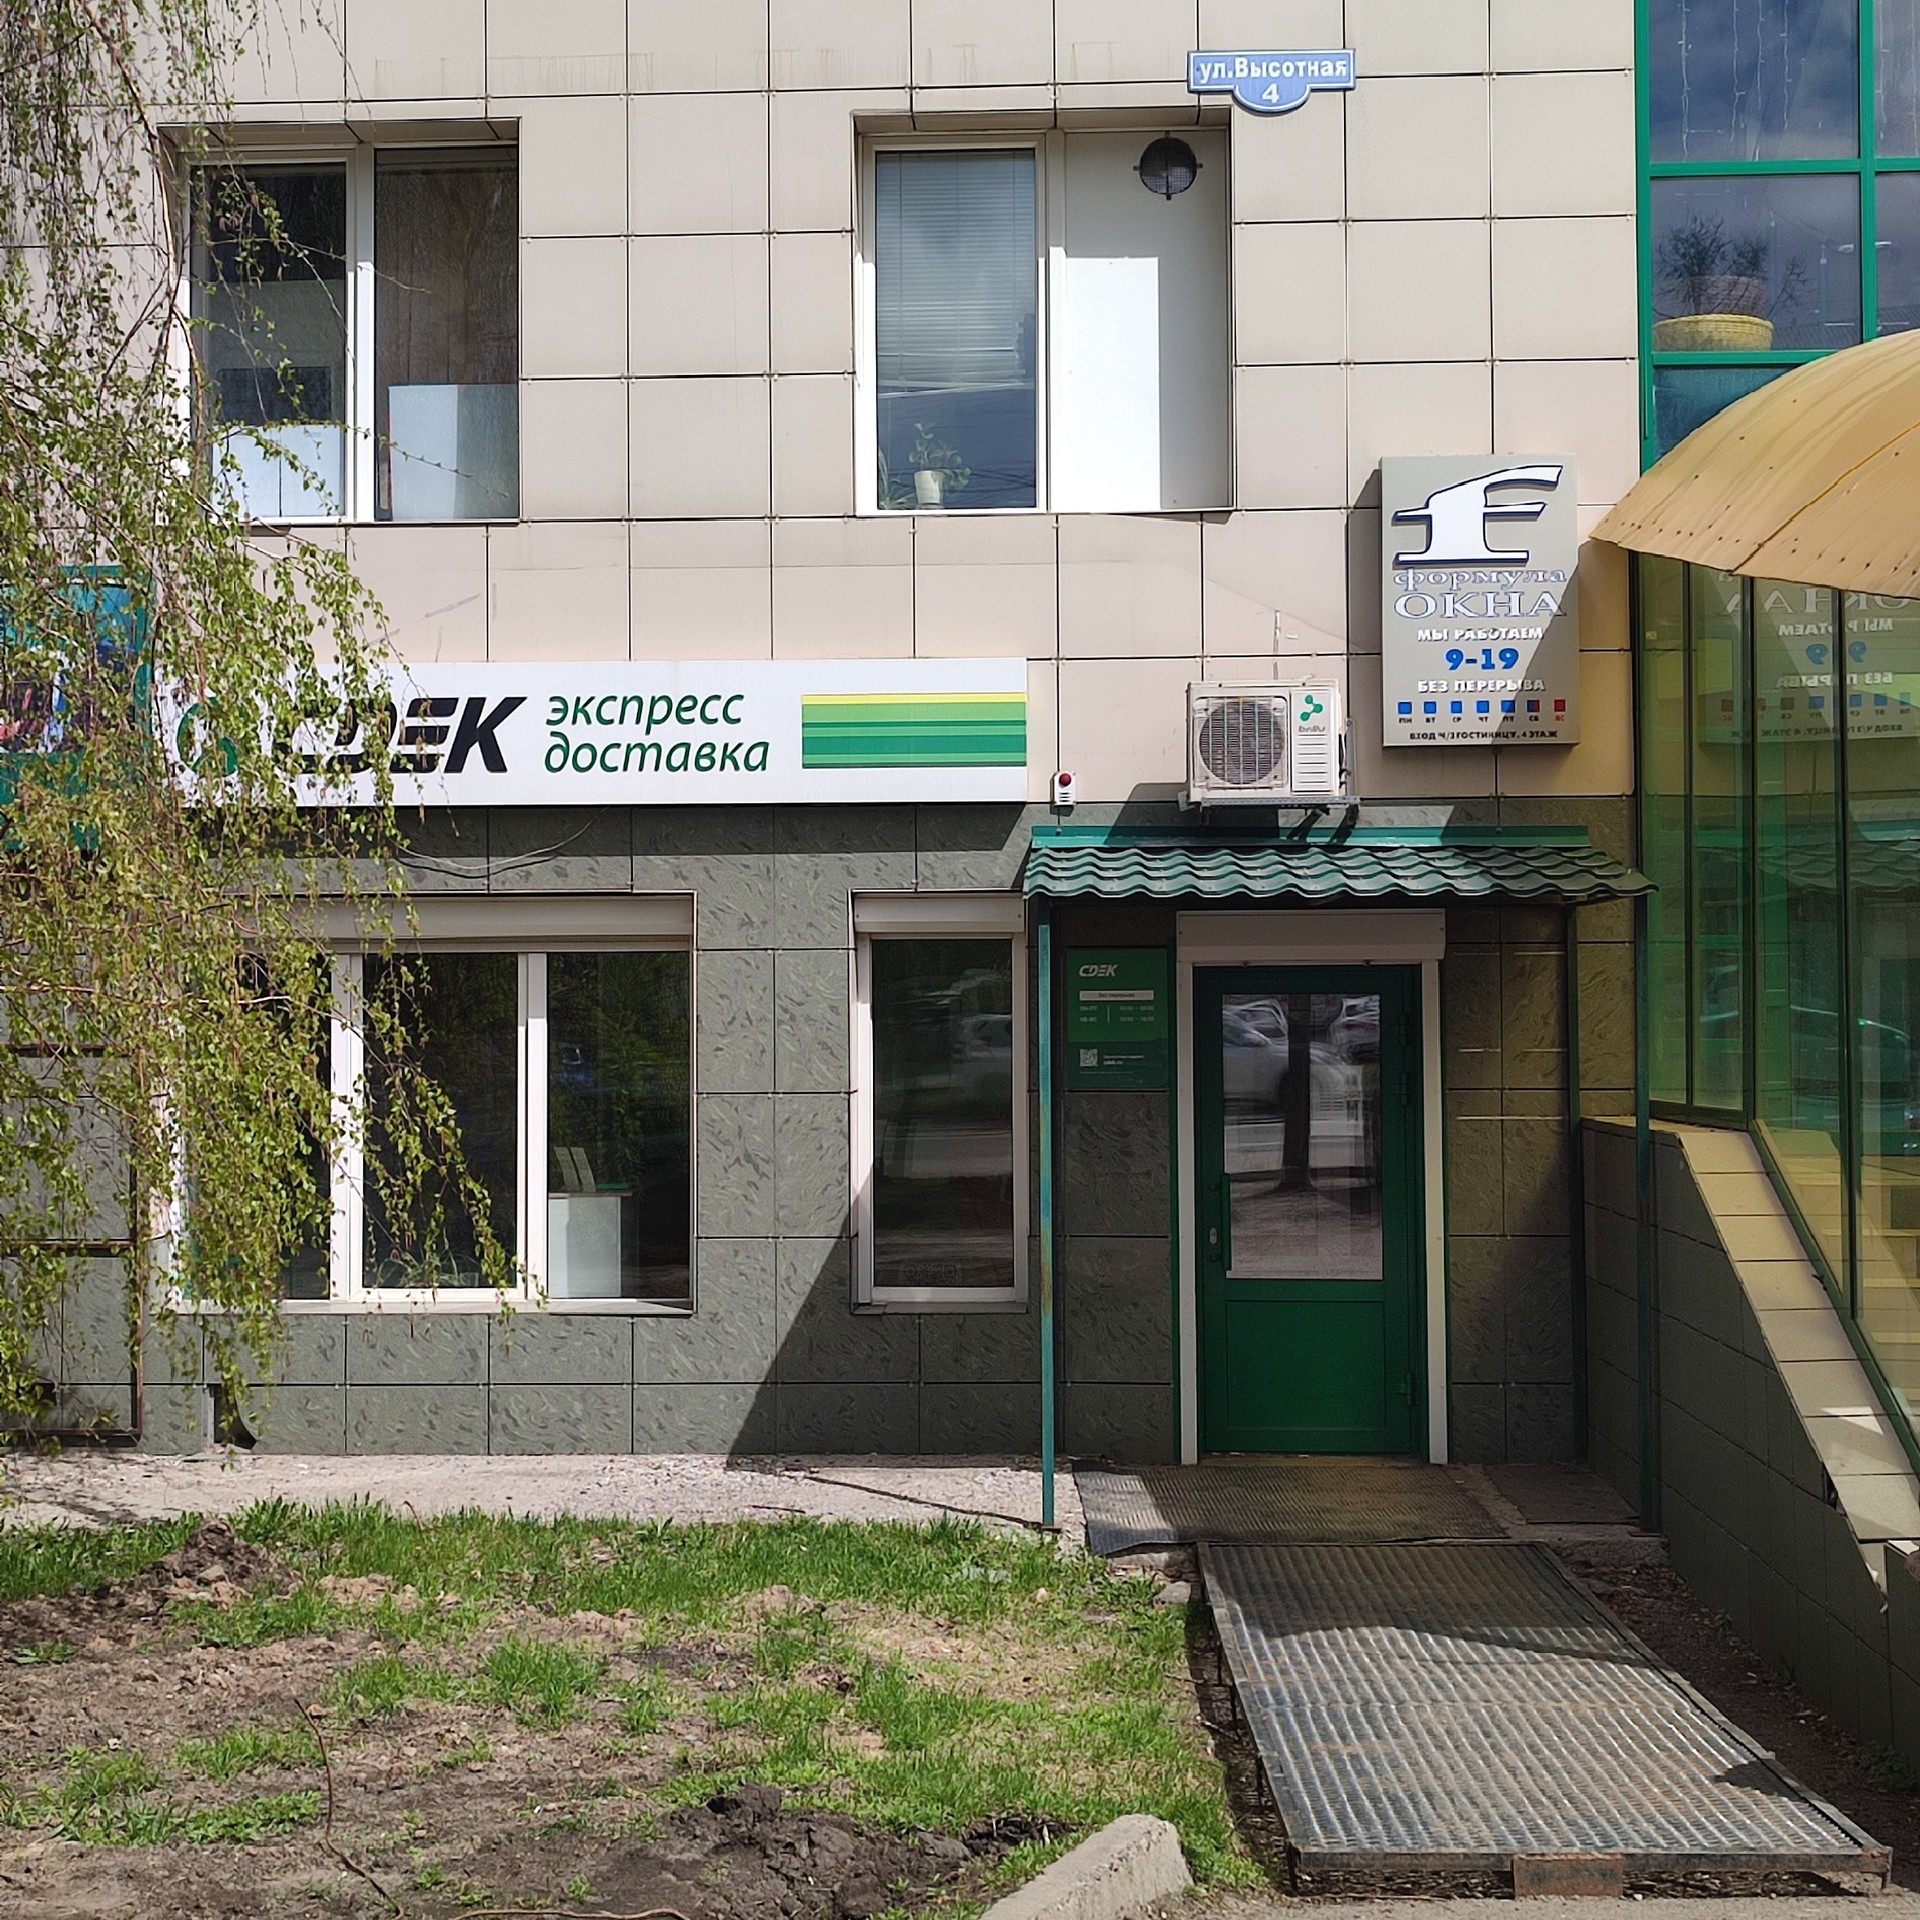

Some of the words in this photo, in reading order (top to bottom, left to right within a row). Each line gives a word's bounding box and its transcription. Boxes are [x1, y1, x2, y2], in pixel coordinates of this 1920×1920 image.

[1261, 83, 1280, 104] 4
[1393, 566, 1567, 592] формула
[1393, 591, 1567, 619] ОКНА
[1416, 629, 1449, 642] МЫ
[1454, 627, 1544, 641] РАБОТАЕМ
[1445, 647, 1520, 671] 9-19
[1417, 679, 1449, 693] БЕЗ
[1454, 678, 1546, 692] ПЕРЕРЫВА
[545, 694, 744, 736] экспресс
[544, 731, 770, 773] доставка
[1079, 964, 1118, 977] CDEK
